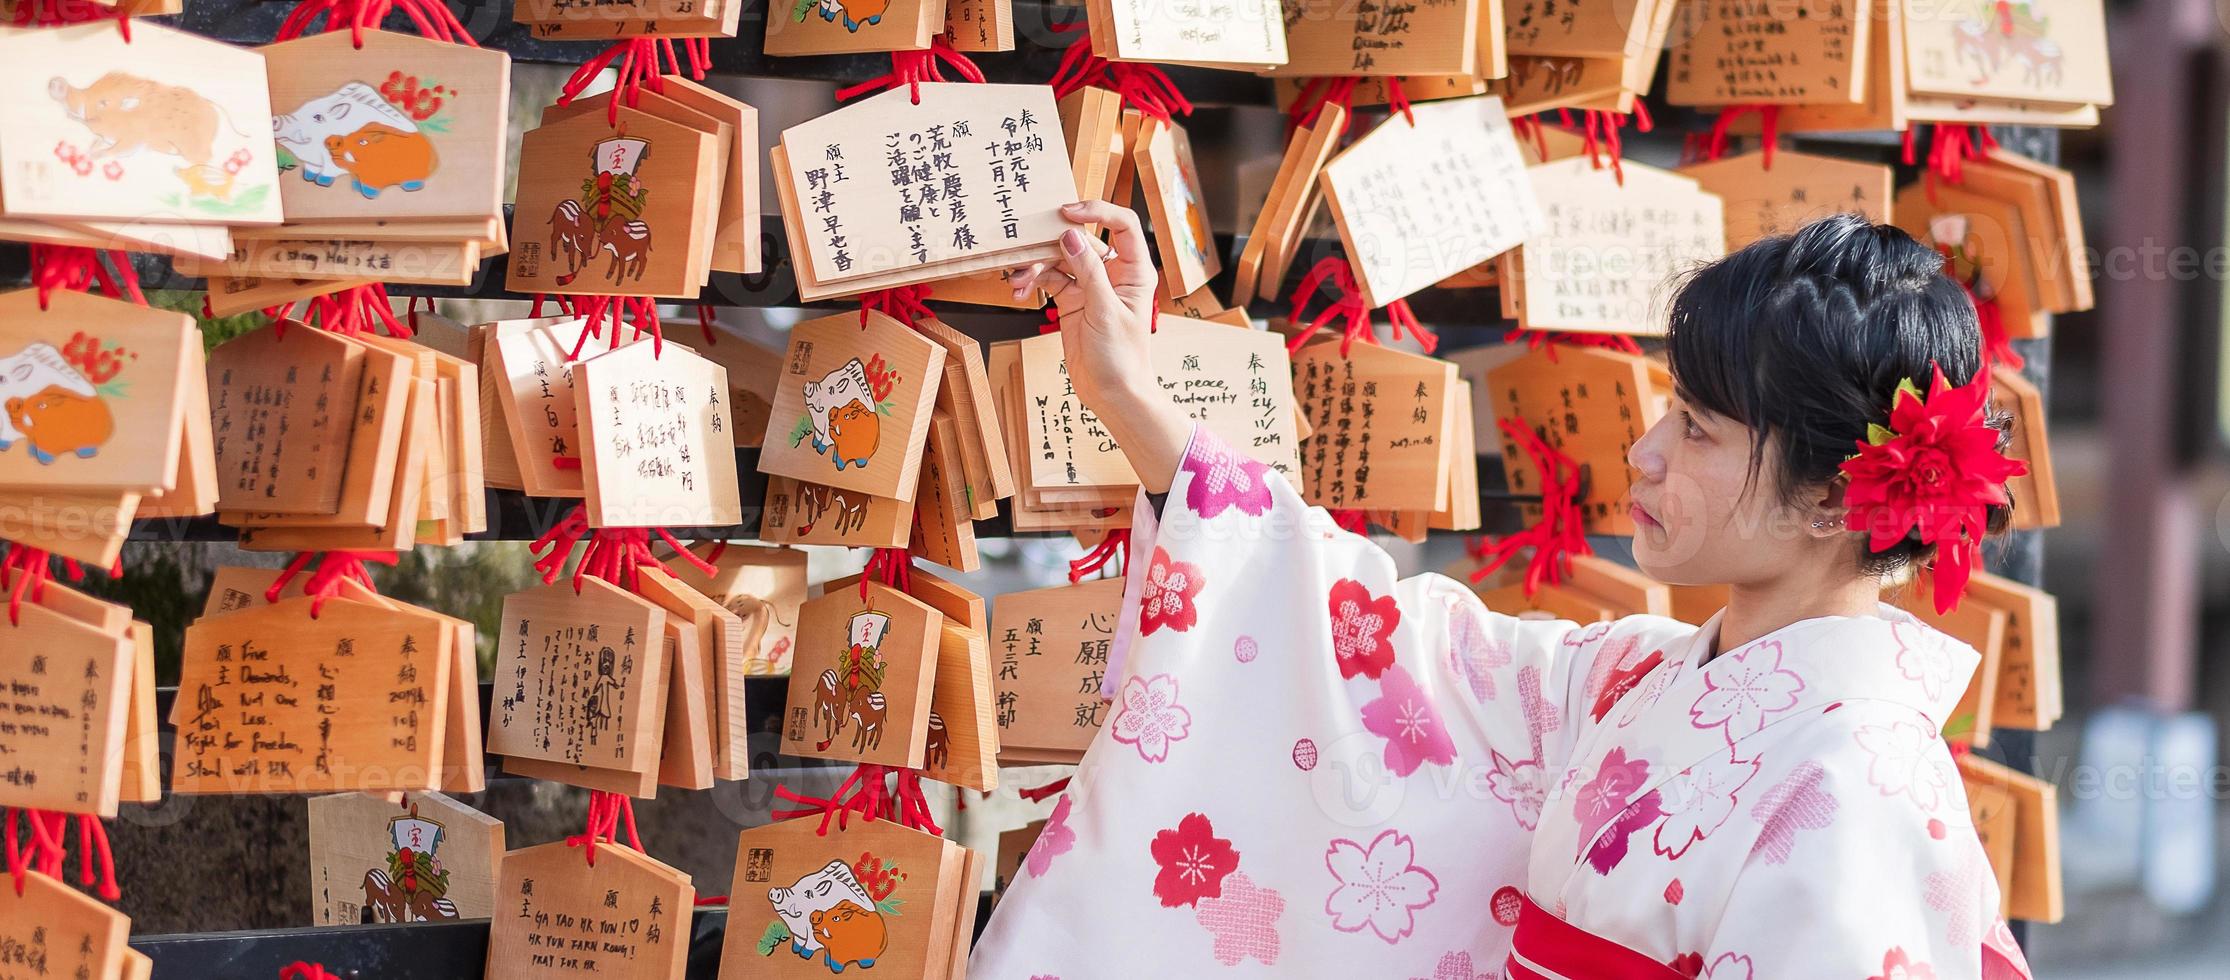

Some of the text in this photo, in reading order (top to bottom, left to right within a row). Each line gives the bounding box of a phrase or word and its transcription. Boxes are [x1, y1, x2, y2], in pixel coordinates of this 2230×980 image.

[952, 120, 973, 138] 願
[1019, 108, 1044, 155] 奉納
[825, 143, 850, 183] 願主
[908, 132, 941, 218] のご健康と
[1000, 116, 1031, 193] 令和元年
[885, 132, 928, 264] ご活躍を願います
[926, 124, 979, 250] 荒牧慶彦様
[984, 141, 1019, 239] 十一月二十三日
[804, 166, 854, 272] 野津早也香
[1181, 354, 1201, 372] 願
[1185, 379, 1229, 391] peace,
[1247, 352, 1267, 396] 奉納
[709, 385, 722, 434] 奉納
[1190, 407, 1207, 420] of
[1412, 380, 1429, 425] 奉納
[1035, 395, 1055, 460] William
[241, 640, 269, 661] Five
[397, 634, 419, 684] 奉納
[516, 619, 530, 660] 願主
[620, 625, 636, 676] 奉納
[998, 628, 1022, 681] 五十三代
[1025, 617, 1044, 657] 願主
[215, 643, 233, 687] 願主
[1073, 612, 1116, 729] 心願成就
[519, 877, 534, 919] 願主
[603, 889, 619, 909] 願
[645, 895, 663, 945] 奉納
[528, 932, 542, 948] HK
[534, 910, 549, 930] GA
[556, 913, 575, 929] YAO
[580, 917, 594, 935] HK
[532, 954, 555, 969] PRAY
